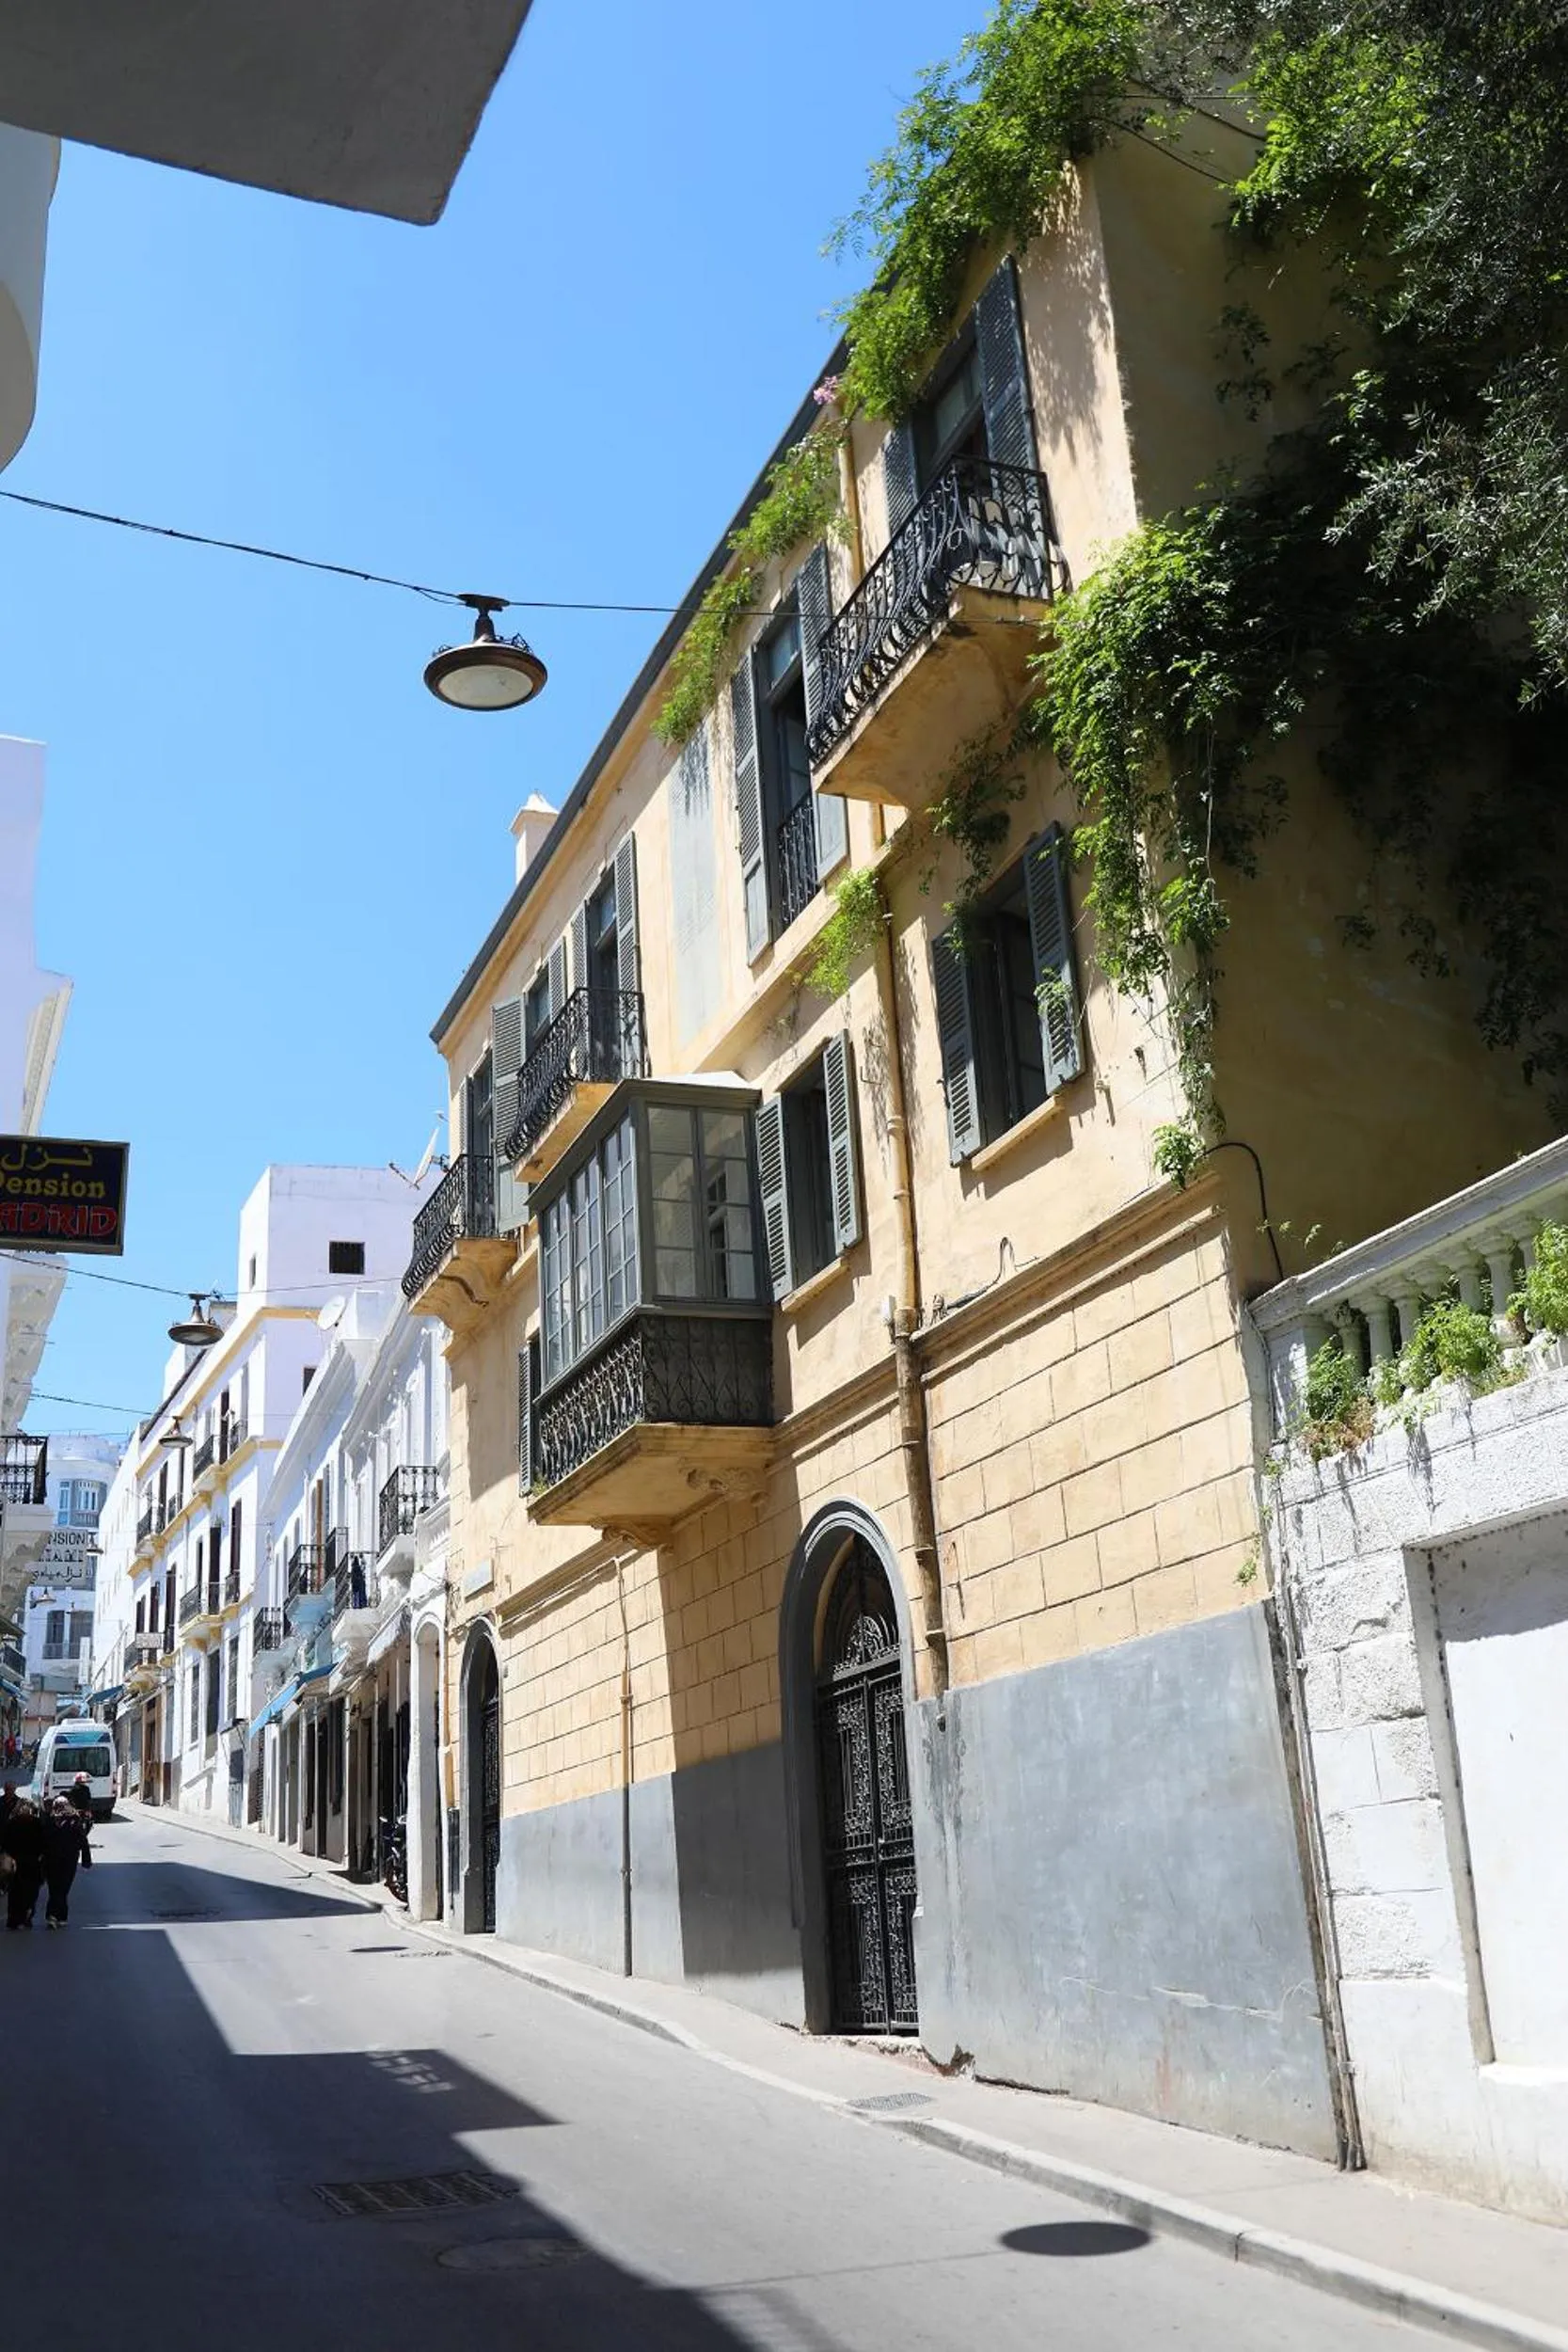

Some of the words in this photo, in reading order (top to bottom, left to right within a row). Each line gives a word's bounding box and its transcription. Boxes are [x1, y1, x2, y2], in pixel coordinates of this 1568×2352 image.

[0, 1170, 106, 1199] ension
[0, 1201, 118, 1237] ADRID
[48, 1532, 86, 1545] NSION
